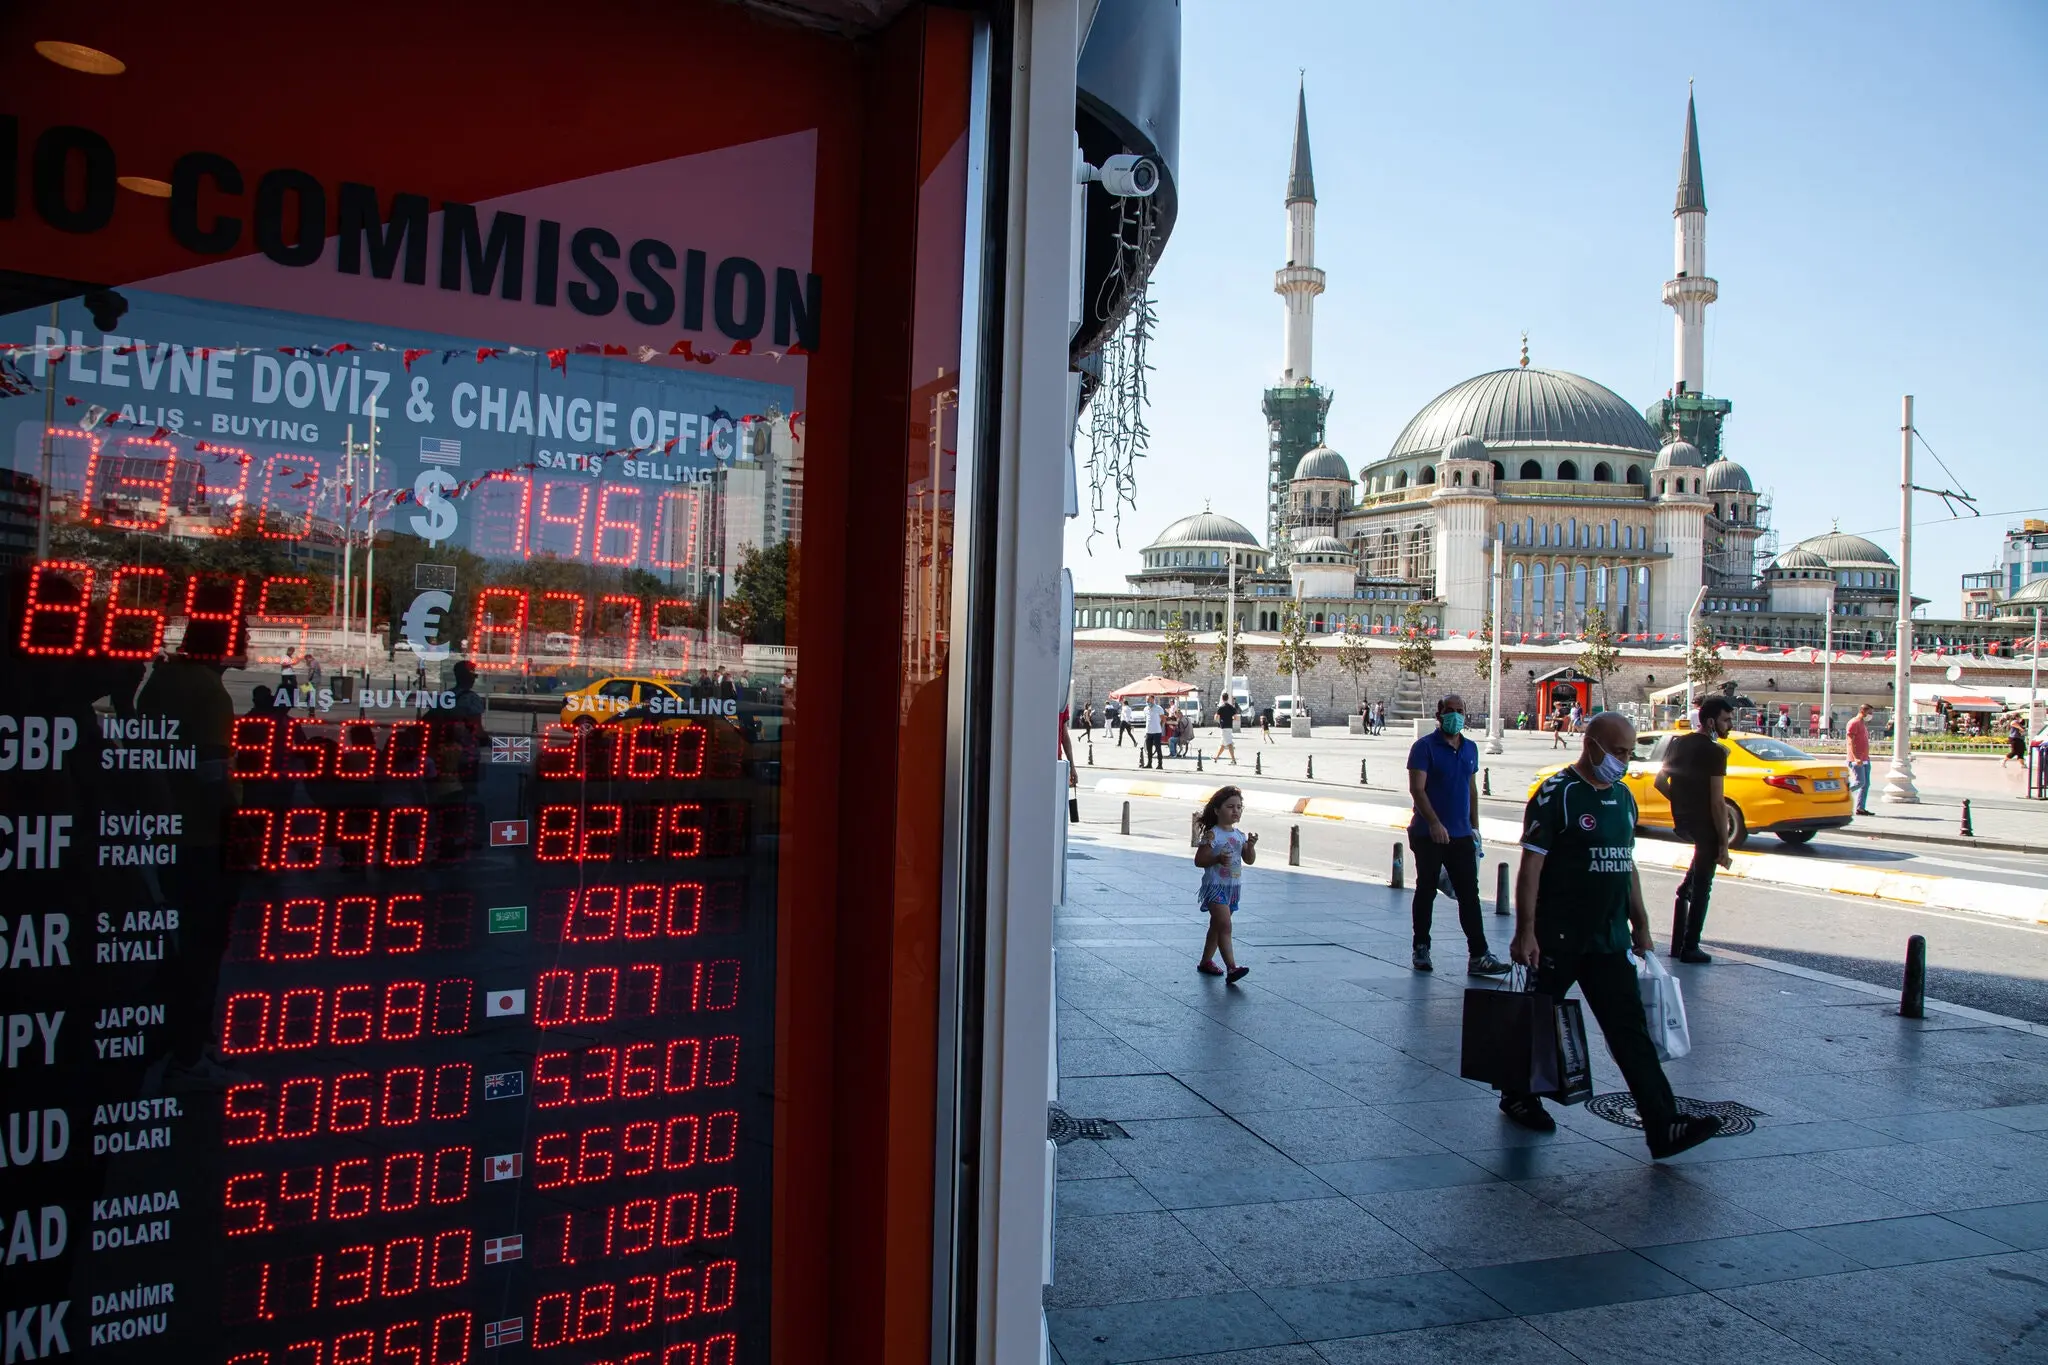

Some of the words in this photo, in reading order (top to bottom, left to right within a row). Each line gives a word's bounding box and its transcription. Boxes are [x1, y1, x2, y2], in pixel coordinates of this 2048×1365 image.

[171, 151, 822, 352] COMMISSION
[34, 324, 236, 400] PLEVNE
[252, 350, 391, 419] DÖVİZ
[406, 376, 435, 423] &
[451, 381, 617, 446] CHANGE
[629, 406, 756, 461] OFFICE
[117, 404, 184, 433] ALIŞ
[212, 413, 319, 443] BUYING
[538, 449, 603, 478] SATIŞ
[623, 459, 712, 484] SELLING
[409, 465, 459, 548] $
[400, 591, 453, 661] €
[273, 688, 334, 712] ALIŞ
[359, 689, 456, 710] BUYING
[566, 694, 630, 717] SATIŞ
[649, 696, 737, 715] SELLING
[102, 713, 181, 740] İNGİLİZ
[0, 715, 78, 772] GBP
[101, 743, 197, 770] STERLİNİ
[99, 810, 184, 841] İSVİÇRE
[98, 844, 177, 866] FRANGI
[97, 912, 117, 933] S.
[122, 909, 180, 932] ARAB
[97, 934, 165, 963] RİYALİ
[95, 1004, 166, 1030] JAPON
[0, 1010, 67, 1069] PY
[94, 1031, 145, 1060] YENİ
[93, 1097, 184, 1126] AVUSTR.
[0, 1107, 70, 1168] UD
[93, 1127, 171, 1155] DOLARI
[92, 1190, 181, 1222] KANADA
[0, 1204, 69, 1267] AD
[92, 1220, 171, 1251] DOLARI
[91, 1281, 175, 1316] DANİMR
[0, 1300, 72, 1364] KK
[91, 1312, 168, 1346] KRONU
